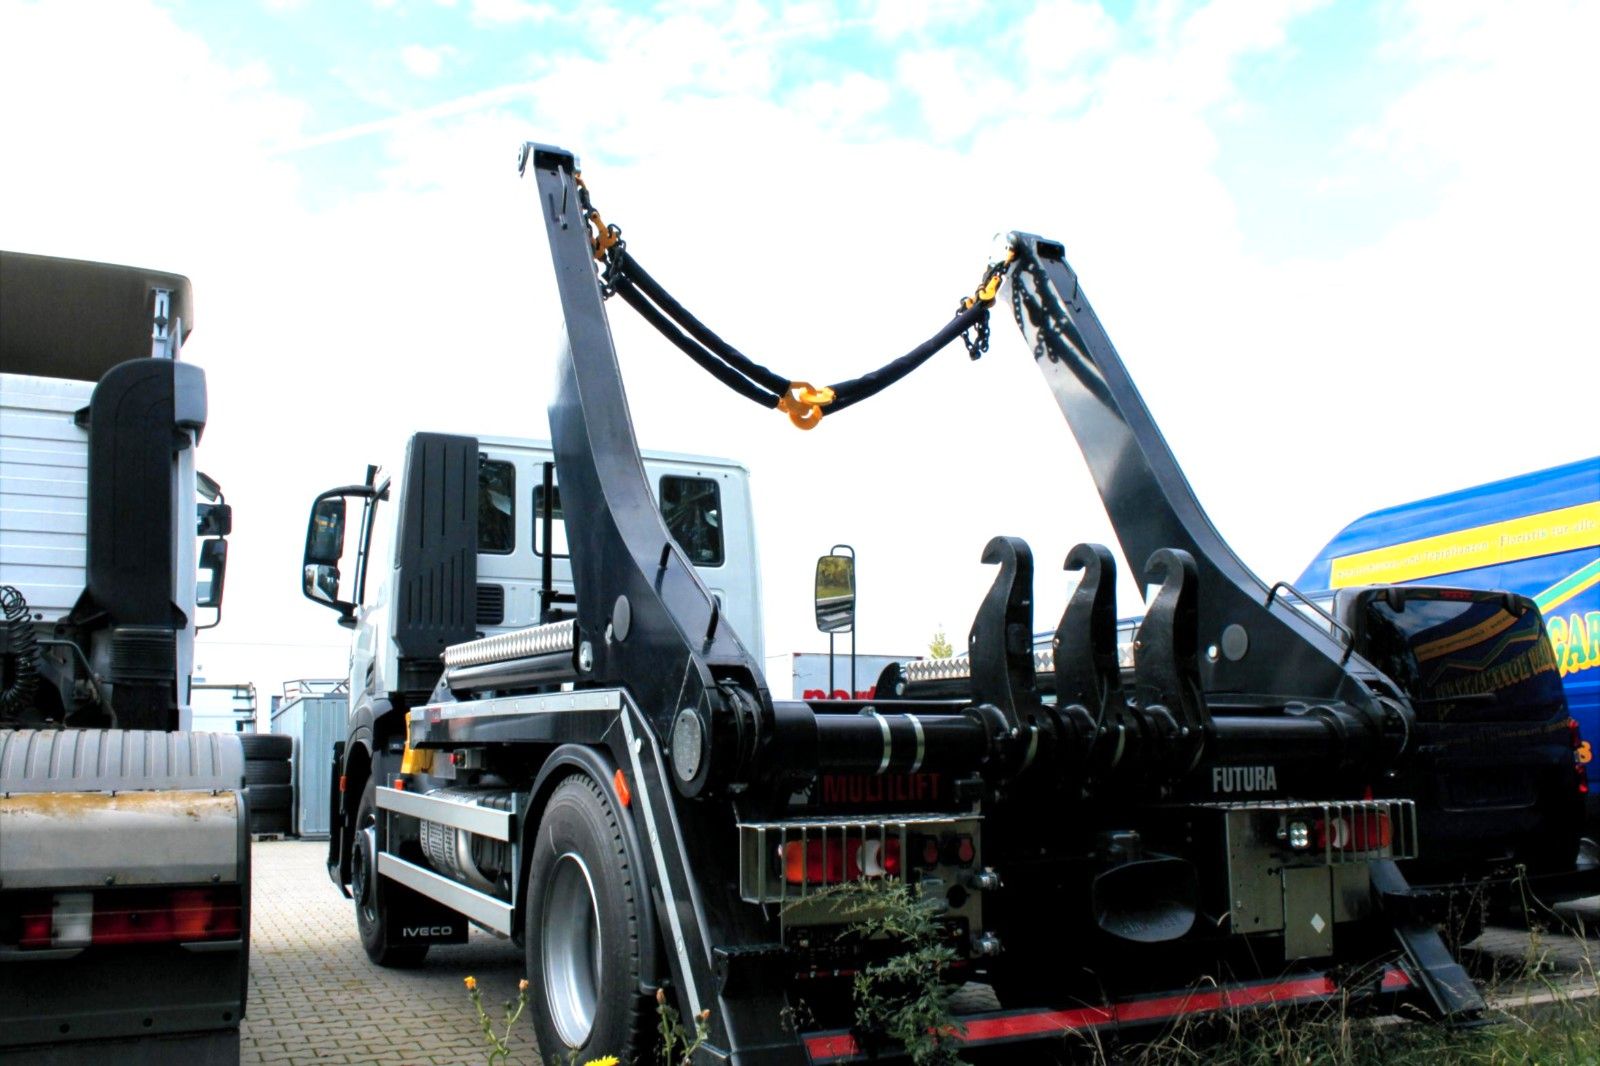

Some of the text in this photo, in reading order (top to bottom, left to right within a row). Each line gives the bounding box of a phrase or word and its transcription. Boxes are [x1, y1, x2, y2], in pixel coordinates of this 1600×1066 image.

[822, 772, 943, 802] MULTILIFT
[1212, 765, 1277, 793] FUTURA
[403, 926, 453, 937] IVECO
